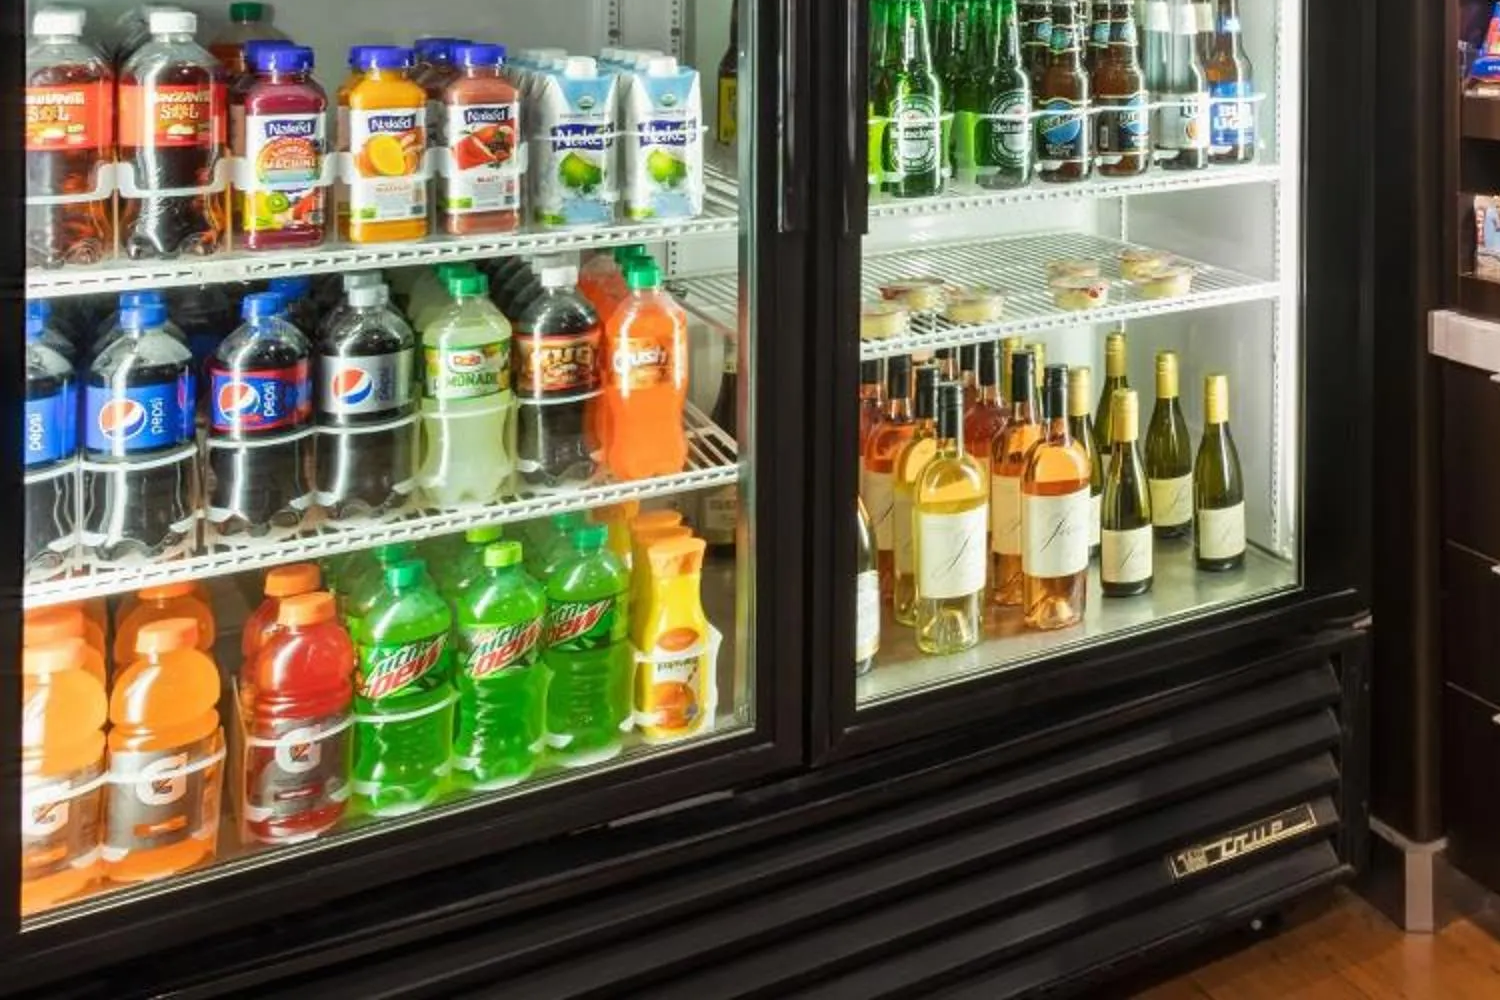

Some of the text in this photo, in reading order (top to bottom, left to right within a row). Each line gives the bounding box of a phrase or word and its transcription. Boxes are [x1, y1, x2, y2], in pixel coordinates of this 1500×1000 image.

[371, 116, 416, 132] Naked
[467, 108, 508, 122] Naked
[269, 119, 312, 136] Naked
[434, 372, 496, 391] LMONADE
[263, 381, 276, 417] pepsi
[151, 397, 164, 436] pepsi
[28, 413, 42, 451] pepsi
